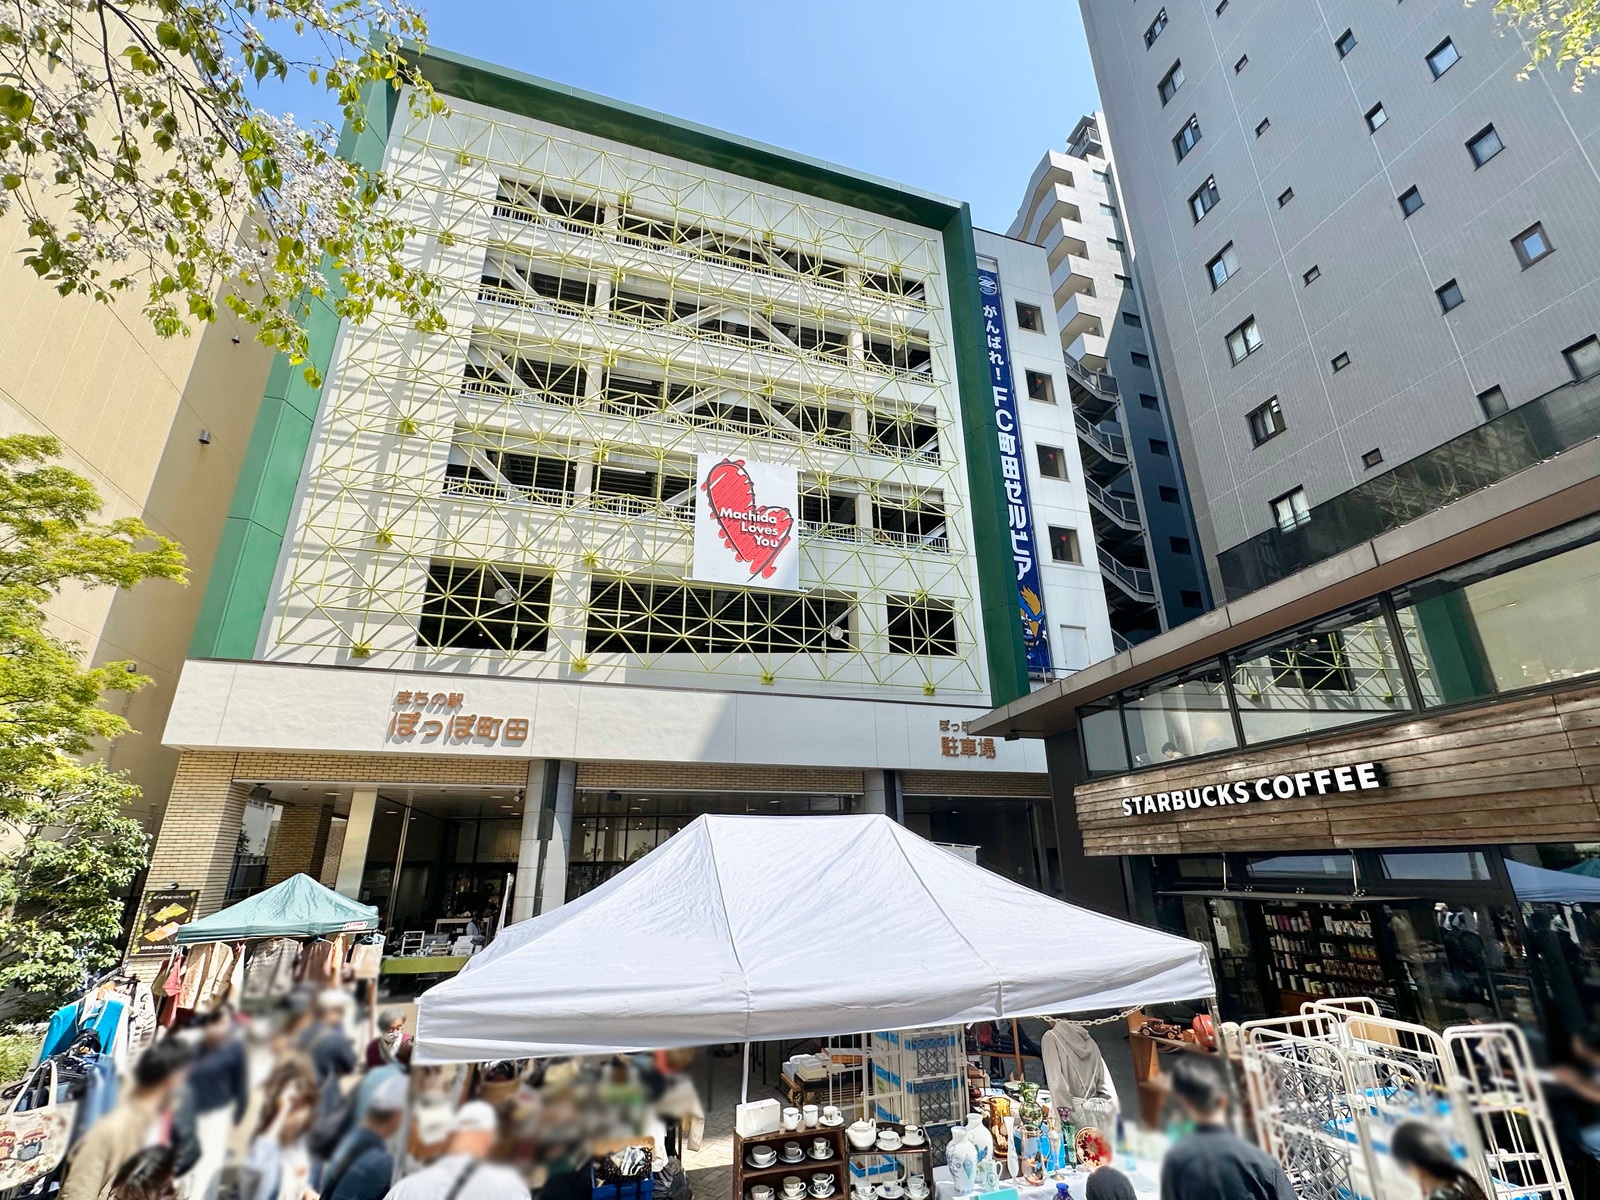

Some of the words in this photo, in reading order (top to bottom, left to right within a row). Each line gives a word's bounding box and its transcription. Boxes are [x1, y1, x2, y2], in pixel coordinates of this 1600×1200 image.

[720, 507, 777, 524] Machida
[741, 522, 779, 535] Loves
[754, 534, 779, 548] You
[396, 690, 464, 707] まちの駅
[390, 712, 529, 740] ぽっぽ町田
[941, 736, 996, 759] 駐車場
[1121, 781, 1250, 816] STARBUCKS
[1255, 763, 1380, 800] COFFEE
